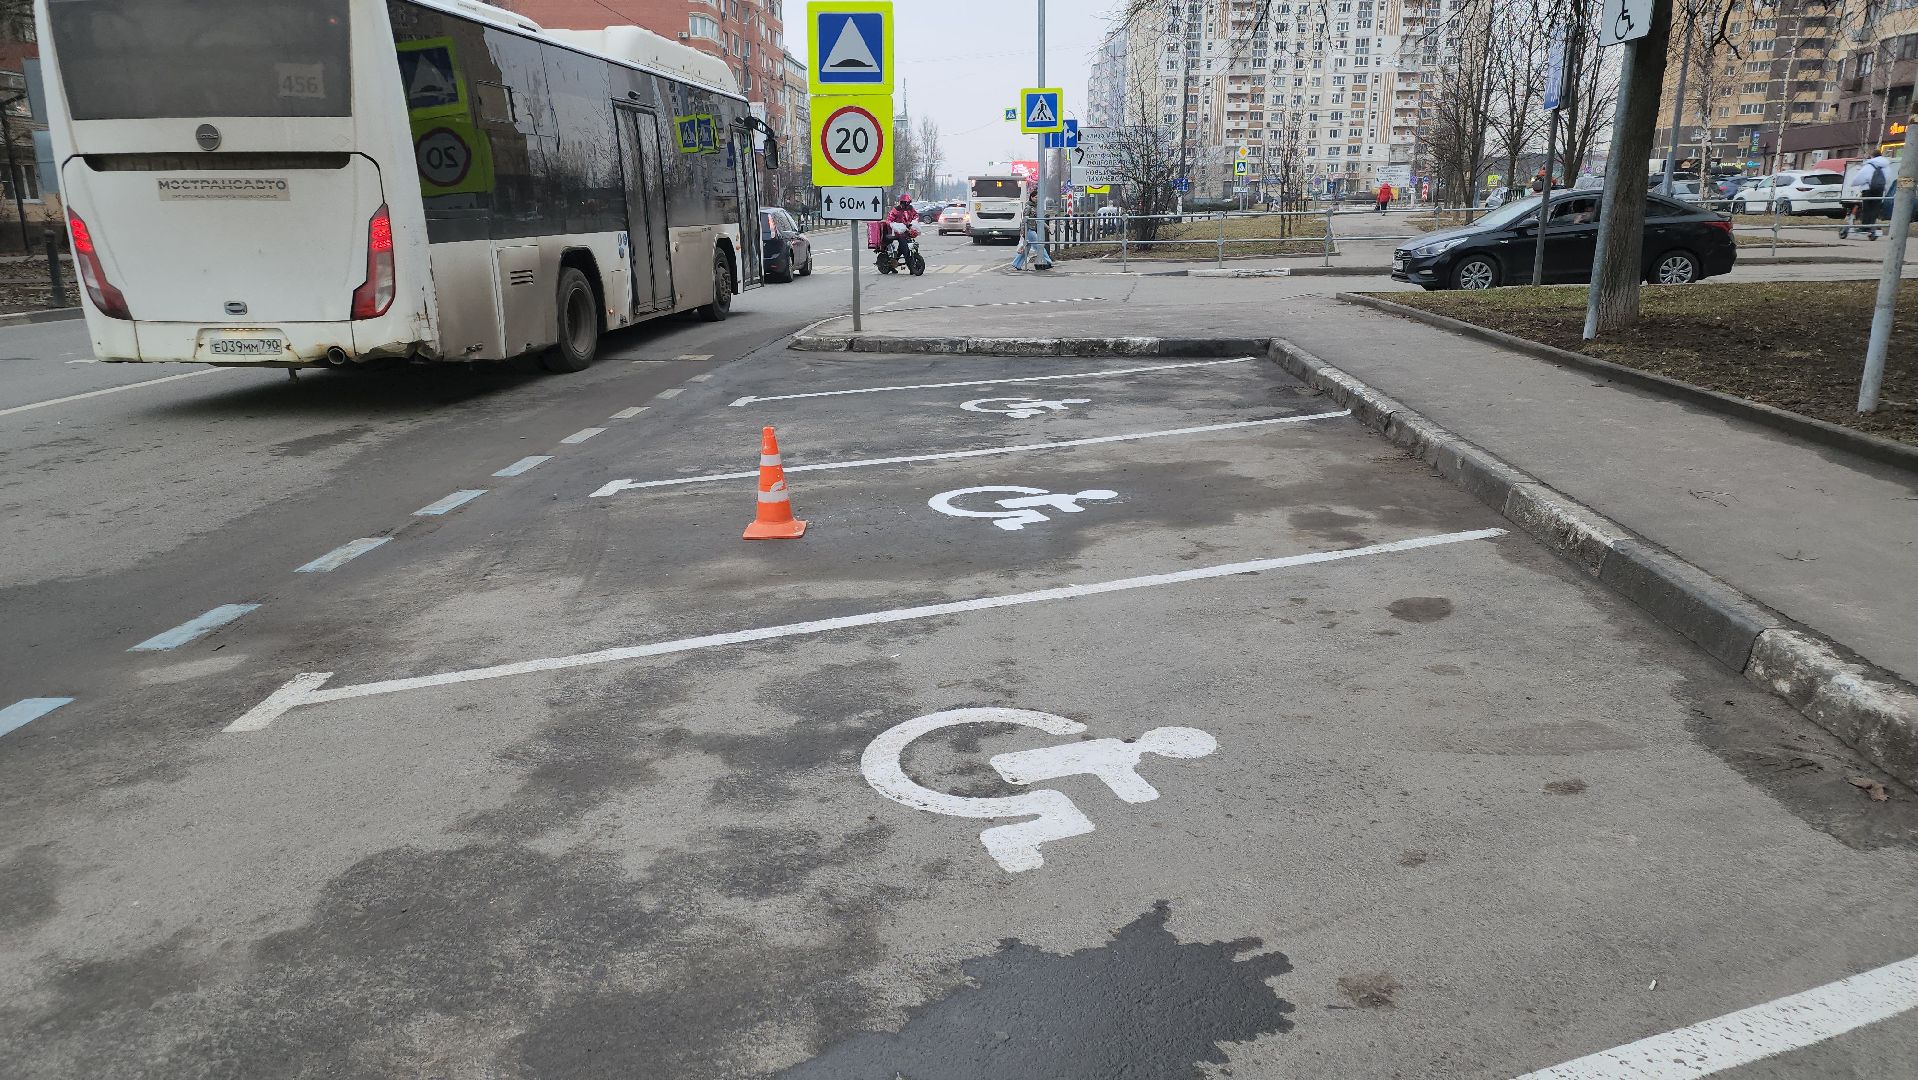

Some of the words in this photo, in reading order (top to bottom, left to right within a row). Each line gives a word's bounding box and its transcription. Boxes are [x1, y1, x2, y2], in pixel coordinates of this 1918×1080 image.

[282, 75, 318, 94] 456
[835, 127, 869, 154] 20
[157, 179, 287, 190] МОСТРАНСАВТО
[839, 197, 866, 210] 60м
